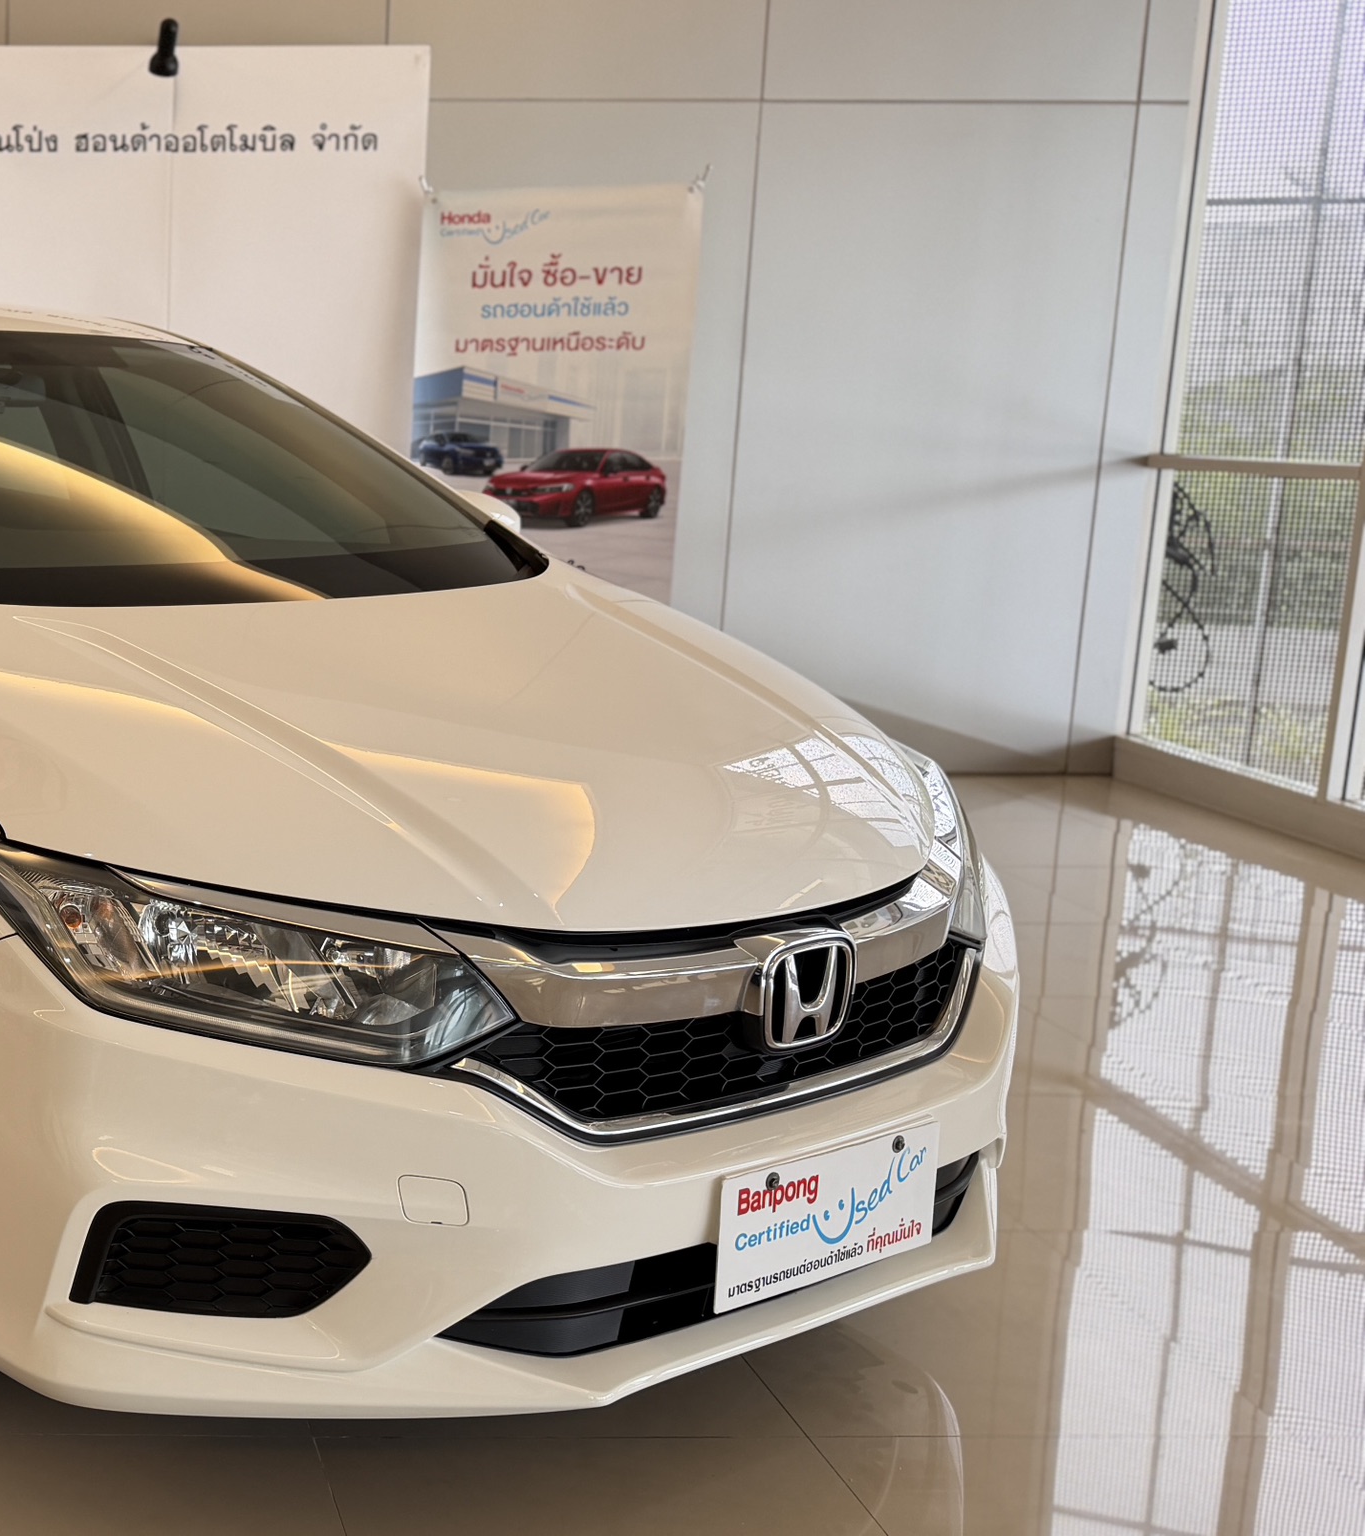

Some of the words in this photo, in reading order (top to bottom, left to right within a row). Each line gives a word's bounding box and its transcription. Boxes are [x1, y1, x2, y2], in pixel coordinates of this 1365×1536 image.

[74, 122, 296, 154] ฮอนด้าออโตโมบิล
[311, 124, 379, 152] จำกัด
[441, 209, 491, 226] Honda
[471, 255, 533, 289] มั่นใจ
[542, 253, 643, 287] ซื้อ-ขาย
[480, 296, 629, 319] รถฮอนด้าใช้แล้ว
[454, 331, 646, 357] มาตรฐานเหนือระดับ
[735, 1213, 812, 1251] Certified
[812, 1155, 895, 1244] Used
[896, 1145, 927, 1184] Car
[737, 1174, 819, 1216] Banpong
[866, 1218, 923, 1256] ที่คุณมั่นใจ
